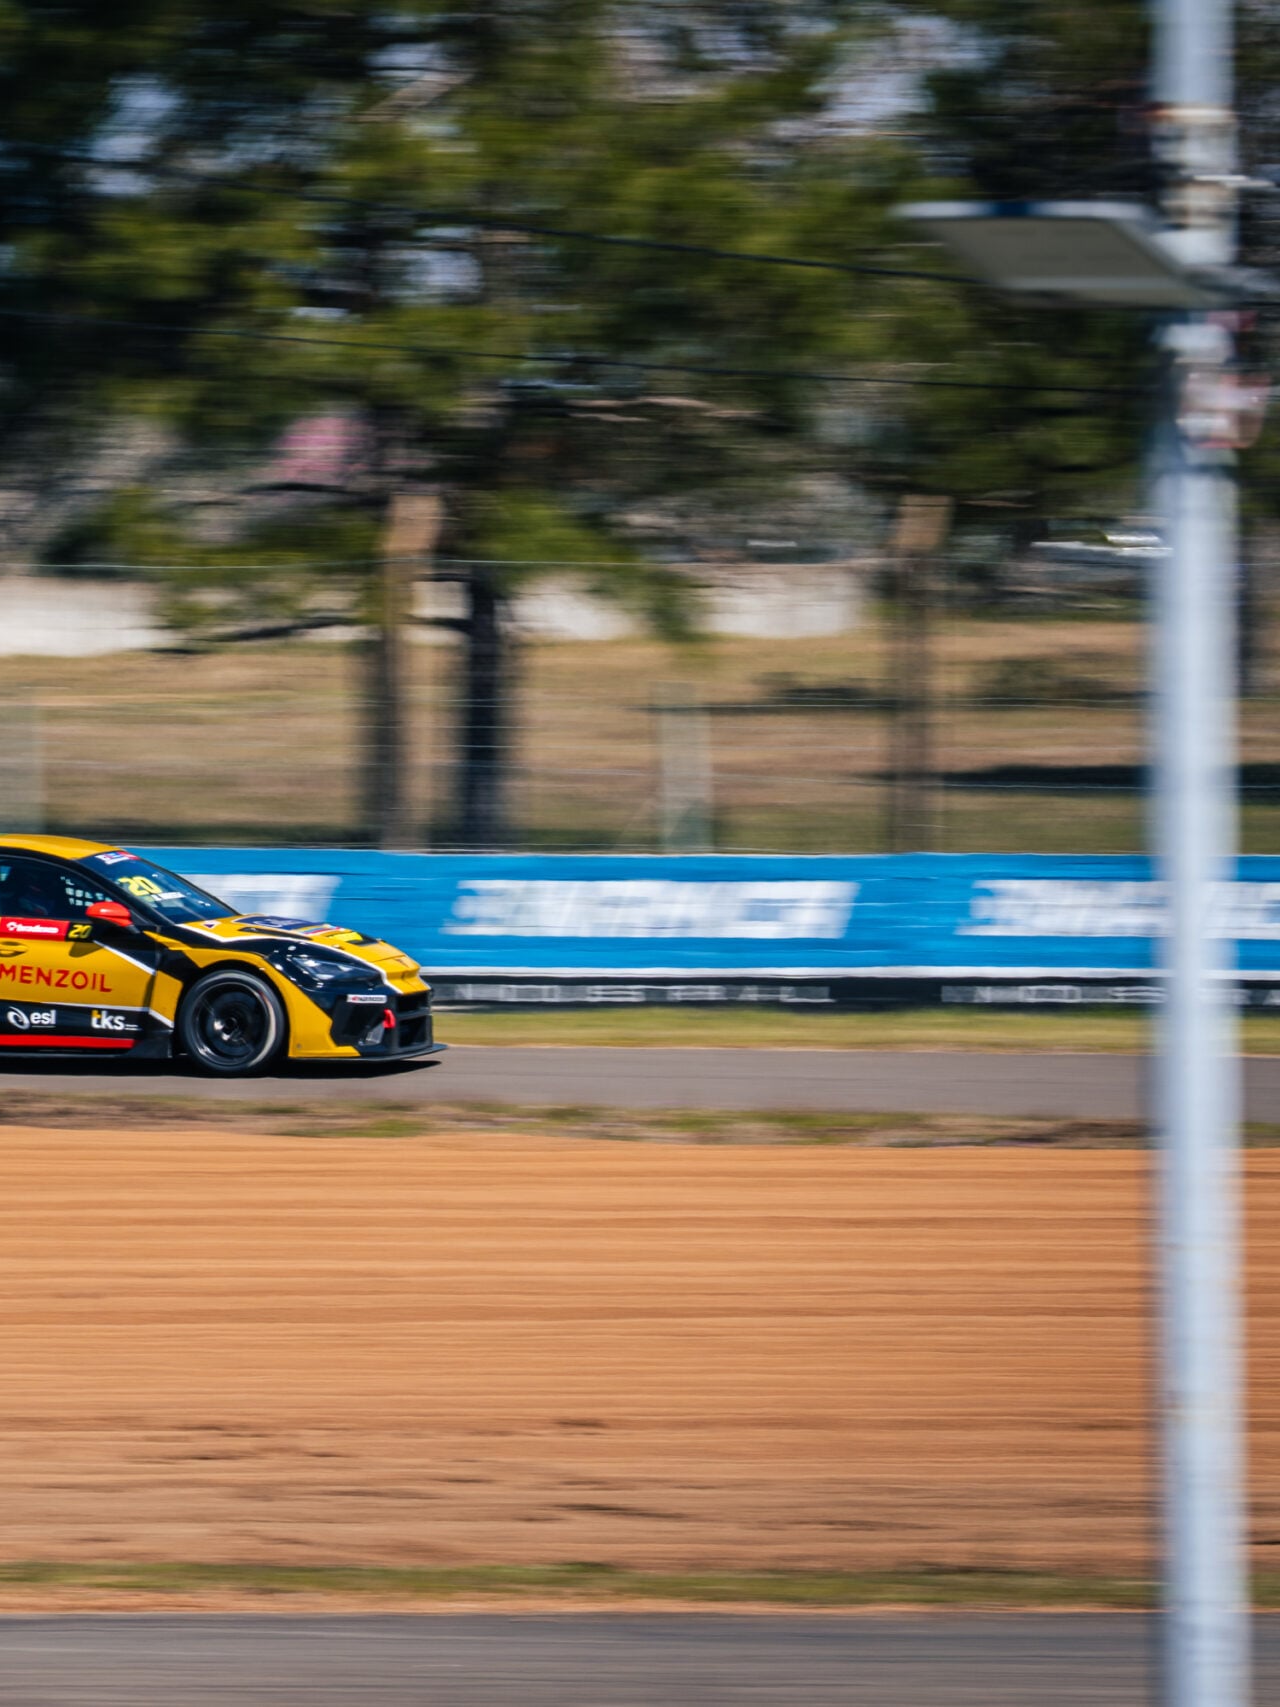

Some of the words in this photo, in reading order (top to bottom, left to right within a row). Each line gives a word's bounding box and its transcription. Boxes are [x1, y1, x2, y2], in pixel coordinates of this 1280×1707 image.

[117, 875, 163, 896] 20
[68, 924, 93, 939] 20
[91, 1009, 126, 1031] tks
